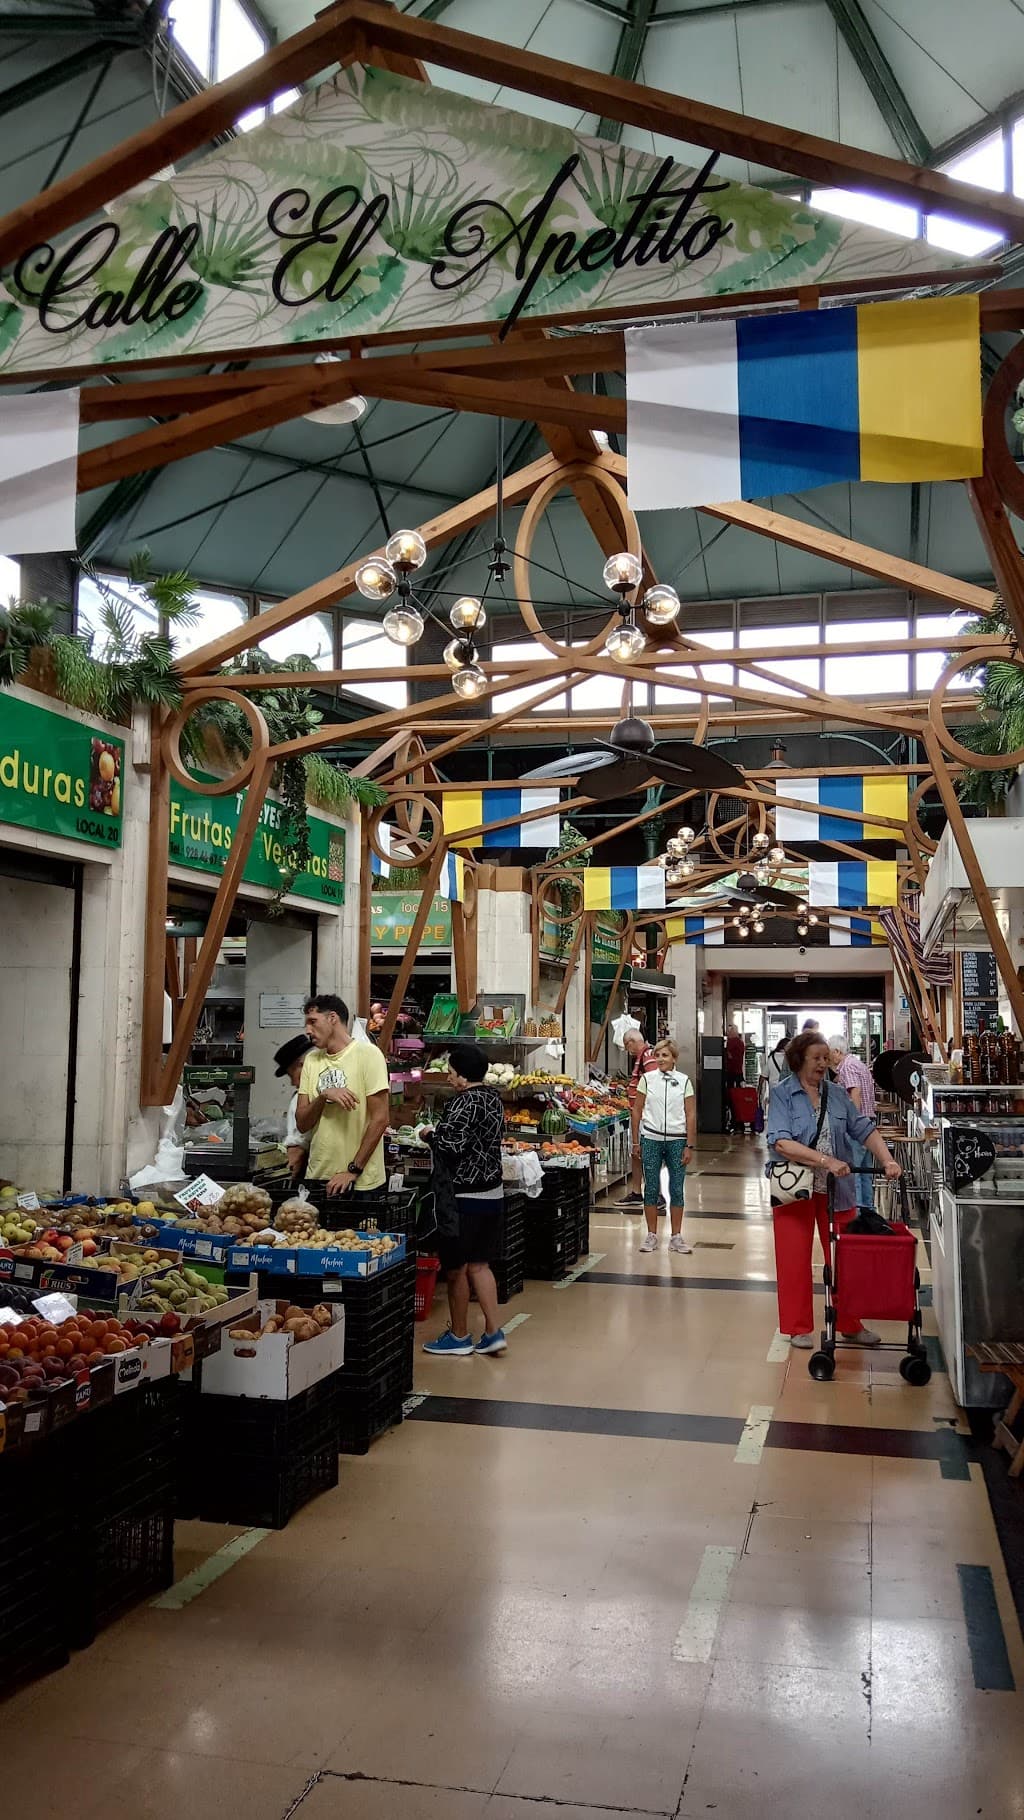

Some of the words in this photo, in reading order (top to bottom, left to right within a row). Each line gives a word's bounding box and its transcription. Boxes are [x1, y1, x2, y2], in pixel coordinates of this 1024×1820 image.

[14, 222, 203, 333] Calle
[267, 184, 390, 307] El
[431, 150, 734, 342] Apetito
[0, 749, 85, 807] duras
[76, 818, 106, 839] LOCAL
[107, 827, 119, 842] 20
[170, 801, 232, 850] Frutas
[321, 884, 337, 898] LOCAL
[434, 901, 448, 912] 15
[374, 926, 387, 940] Y
[50, 1280, 71, 1290] RIUS
